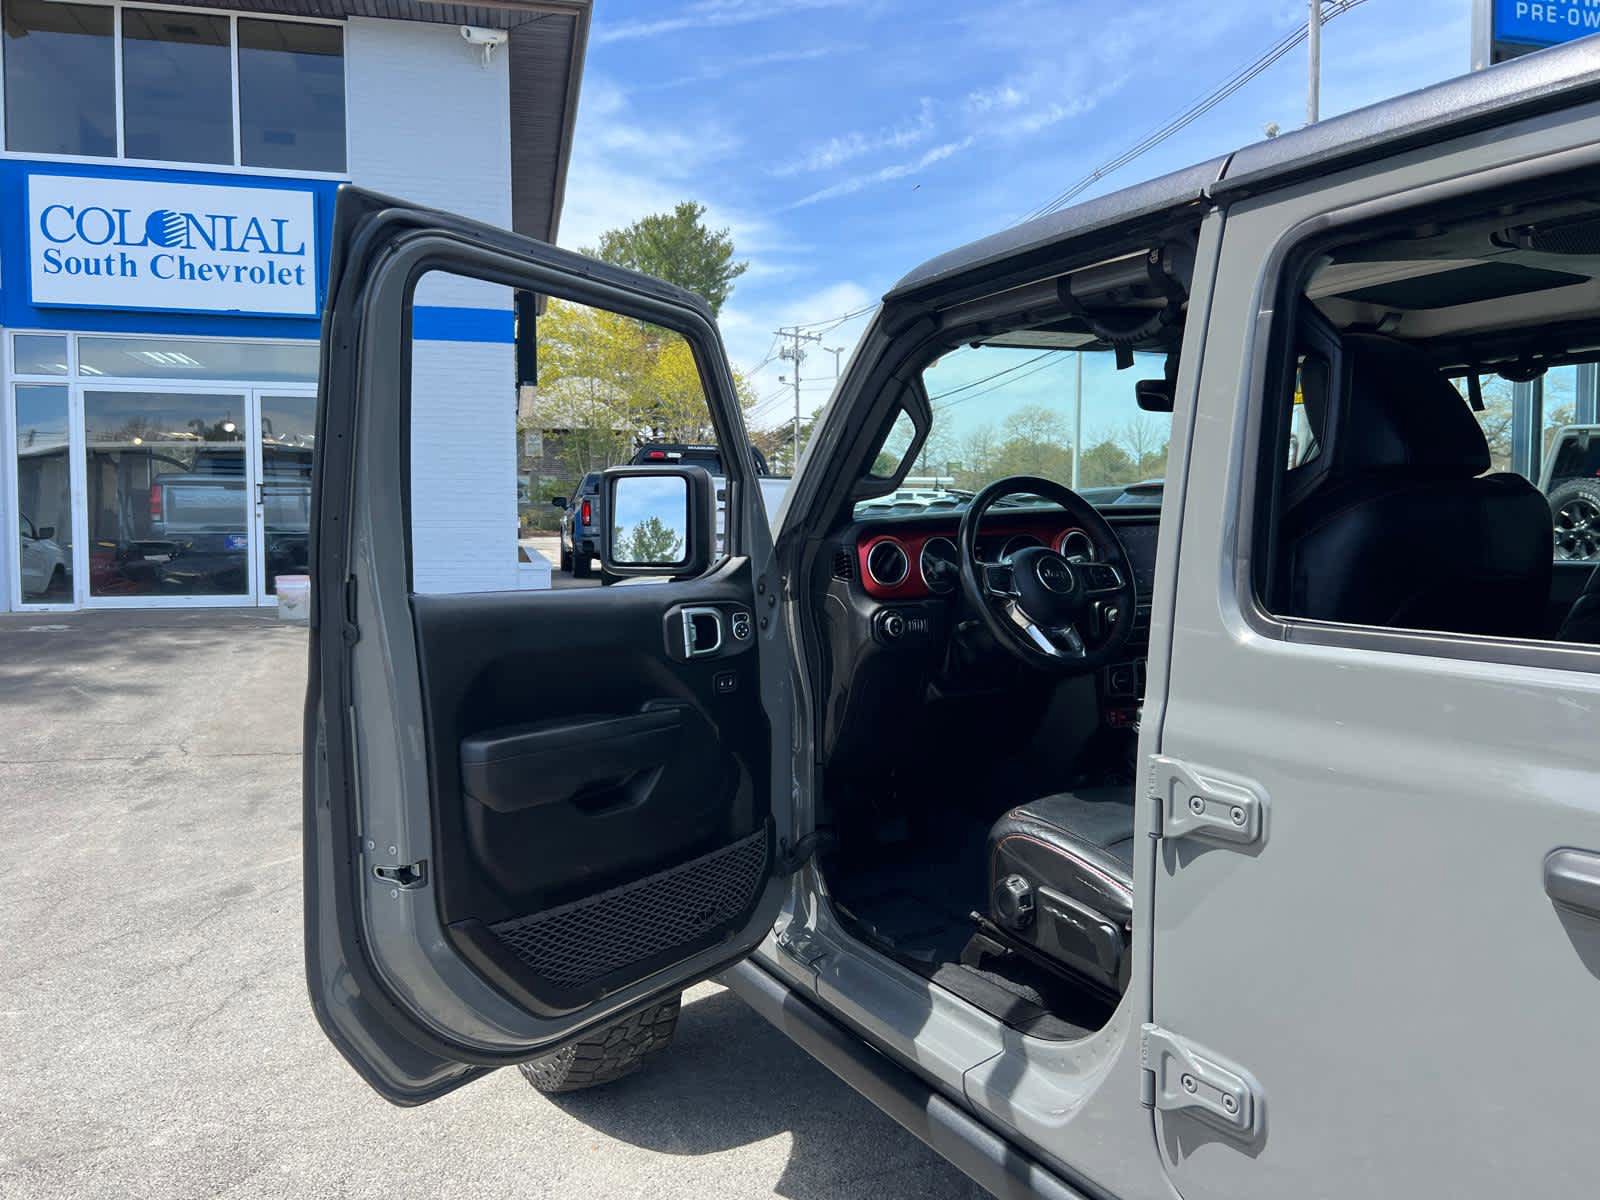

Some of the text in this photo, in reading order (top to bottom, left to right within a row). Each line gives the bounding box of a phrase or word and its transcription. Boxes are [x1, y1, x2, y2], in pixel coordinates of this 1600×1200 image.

[40, 204, 305, 255] COLONIAL
[43, 248, 305, 285] South Chevrolet
